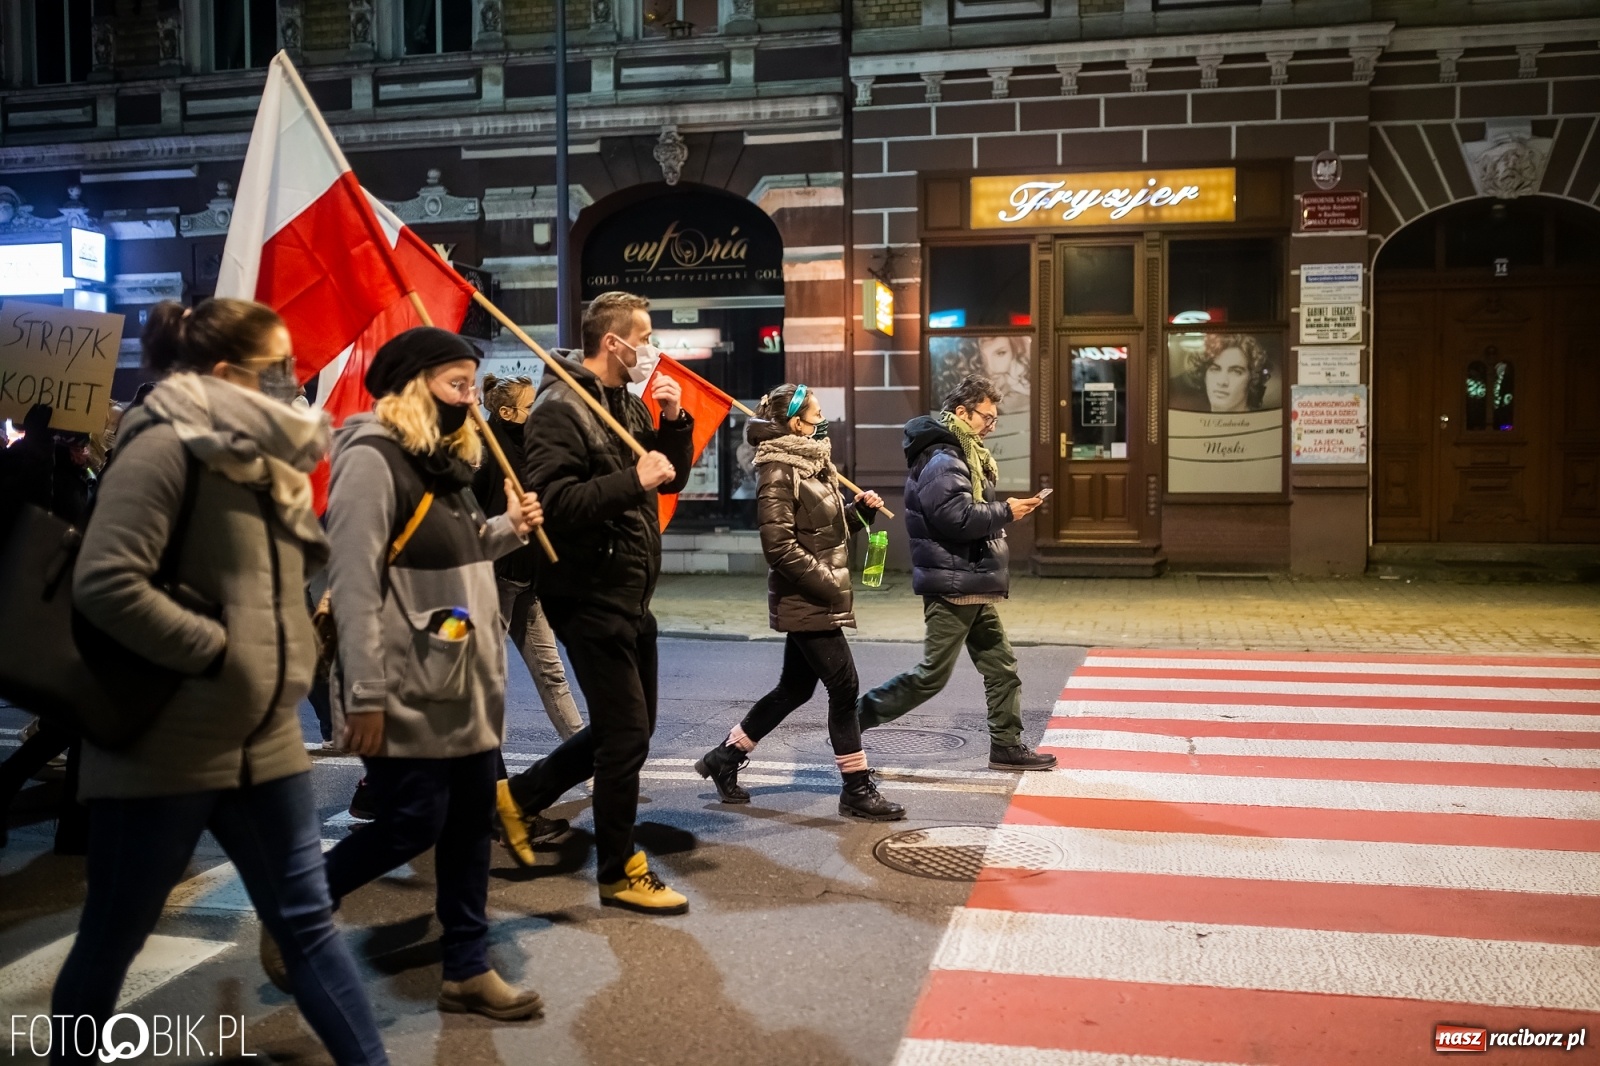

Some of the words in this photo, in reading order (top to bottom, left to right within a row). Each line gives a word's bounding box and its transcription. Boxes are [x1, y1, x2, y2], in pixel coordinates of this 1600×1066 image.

[998, 178, 1200, 222] Fryzjer
[587, 275, 619, 286] GOLD
[0, 371, 103, 415] KOBIET
[1203, 441, 1246, 457] Męski
